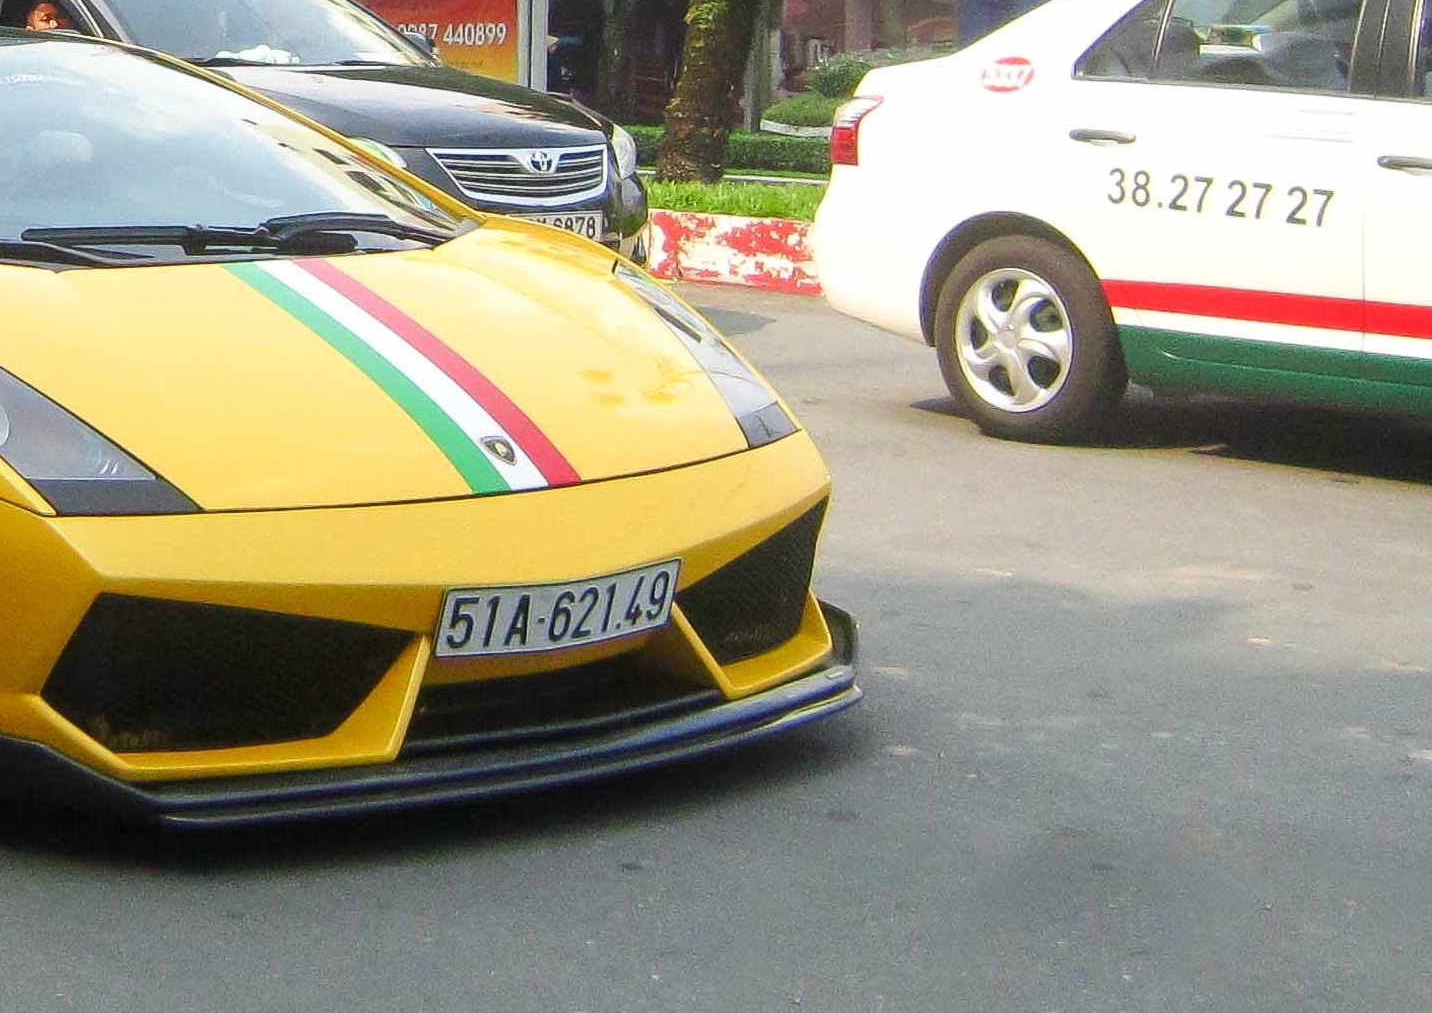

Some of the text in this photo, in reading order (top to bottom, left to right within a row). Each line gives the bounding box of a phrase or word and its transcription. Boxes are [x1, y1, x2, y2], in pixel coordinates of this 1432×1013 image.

[442, 22, 507, 46] 440899
[1107, 167, 1335, 228] 38.27 27 27
[445, 570, 671, 650] 51A-621.49
